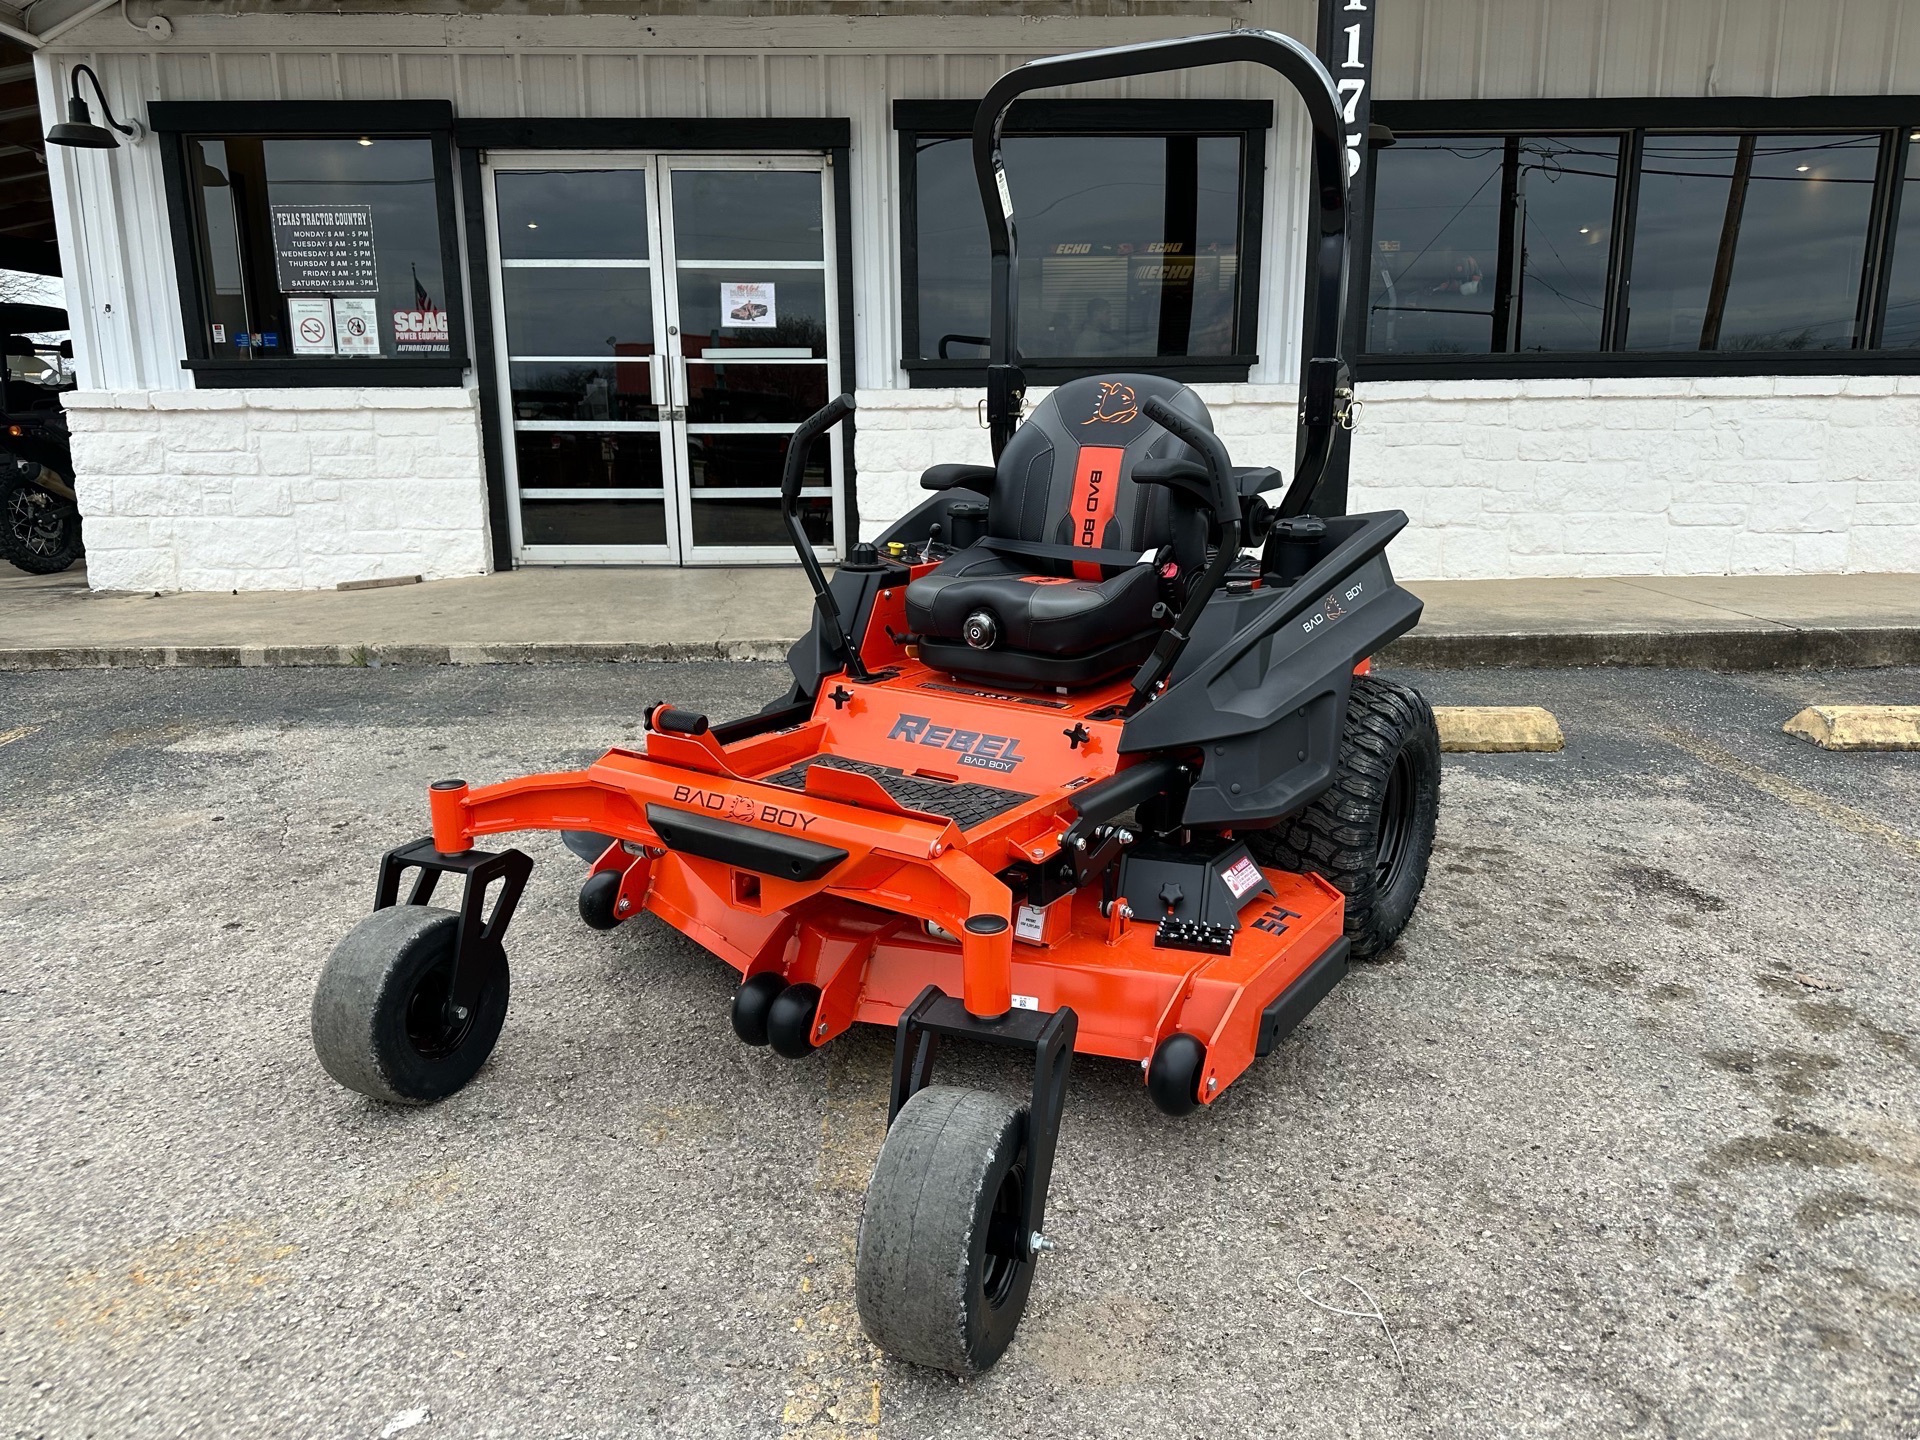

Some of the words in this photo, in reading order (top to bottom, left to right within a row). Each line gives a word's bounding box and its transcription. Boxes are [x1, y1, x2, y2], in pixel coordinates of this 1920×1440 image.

[276, 213, 300, 226] TEXAS
[301, 213, 334, 226] TRACTOR
[335, 213, 366, 226] COUNTRY
[1056, 244, 1092, 254] ECHO
[1148, 242, 1183, 253] ECHO
[1146, 266, 1194, 279] ECHO
[394, 312, 448, 332] SCAG
[396, 332, 418, 340] POWER
[1148, 404, 1193, 434] BOY
[1086, 470, 1102, 512] BAD
[1082, 519, 1096, 548] BO
[1302, 614, 1324, 633] BAD
[1345, 582, 1363, 601] BOY
[887, 712, 1025, 762] REBEL
[964, 756, 986, 766] BAD
[989, 760, 1012, 771] BOY
[674, 786, 725, 810] BAD
[760, 805, 818, 831] BOY
[1250, 906, 1302, 936] 54
